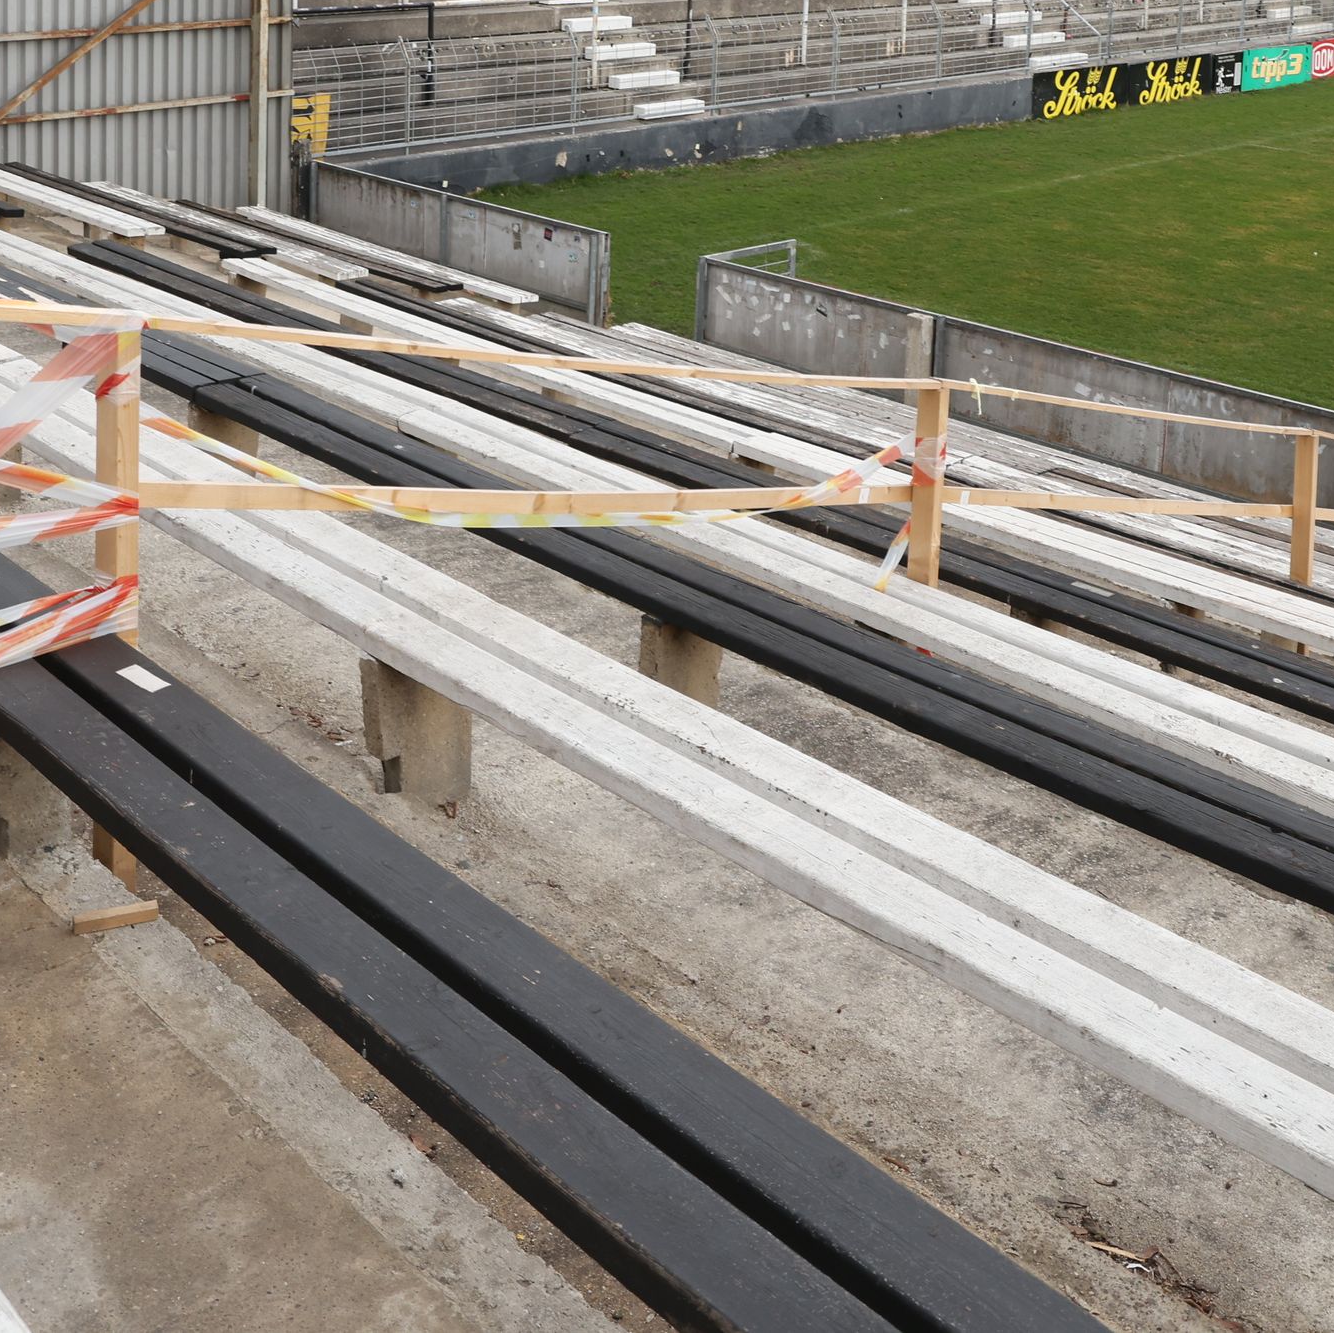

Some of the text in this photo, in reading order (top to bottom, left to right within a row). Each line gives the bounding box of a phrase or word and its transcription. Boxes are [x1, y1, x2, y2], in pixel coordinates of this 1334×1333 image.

[1251, 54, 1304, 83] tipp3
[1315, 50, 1334, 71] DOM
[1043, 66, 1117, 120] Ströck
[1139, 57, 1203, 106] Ströck
